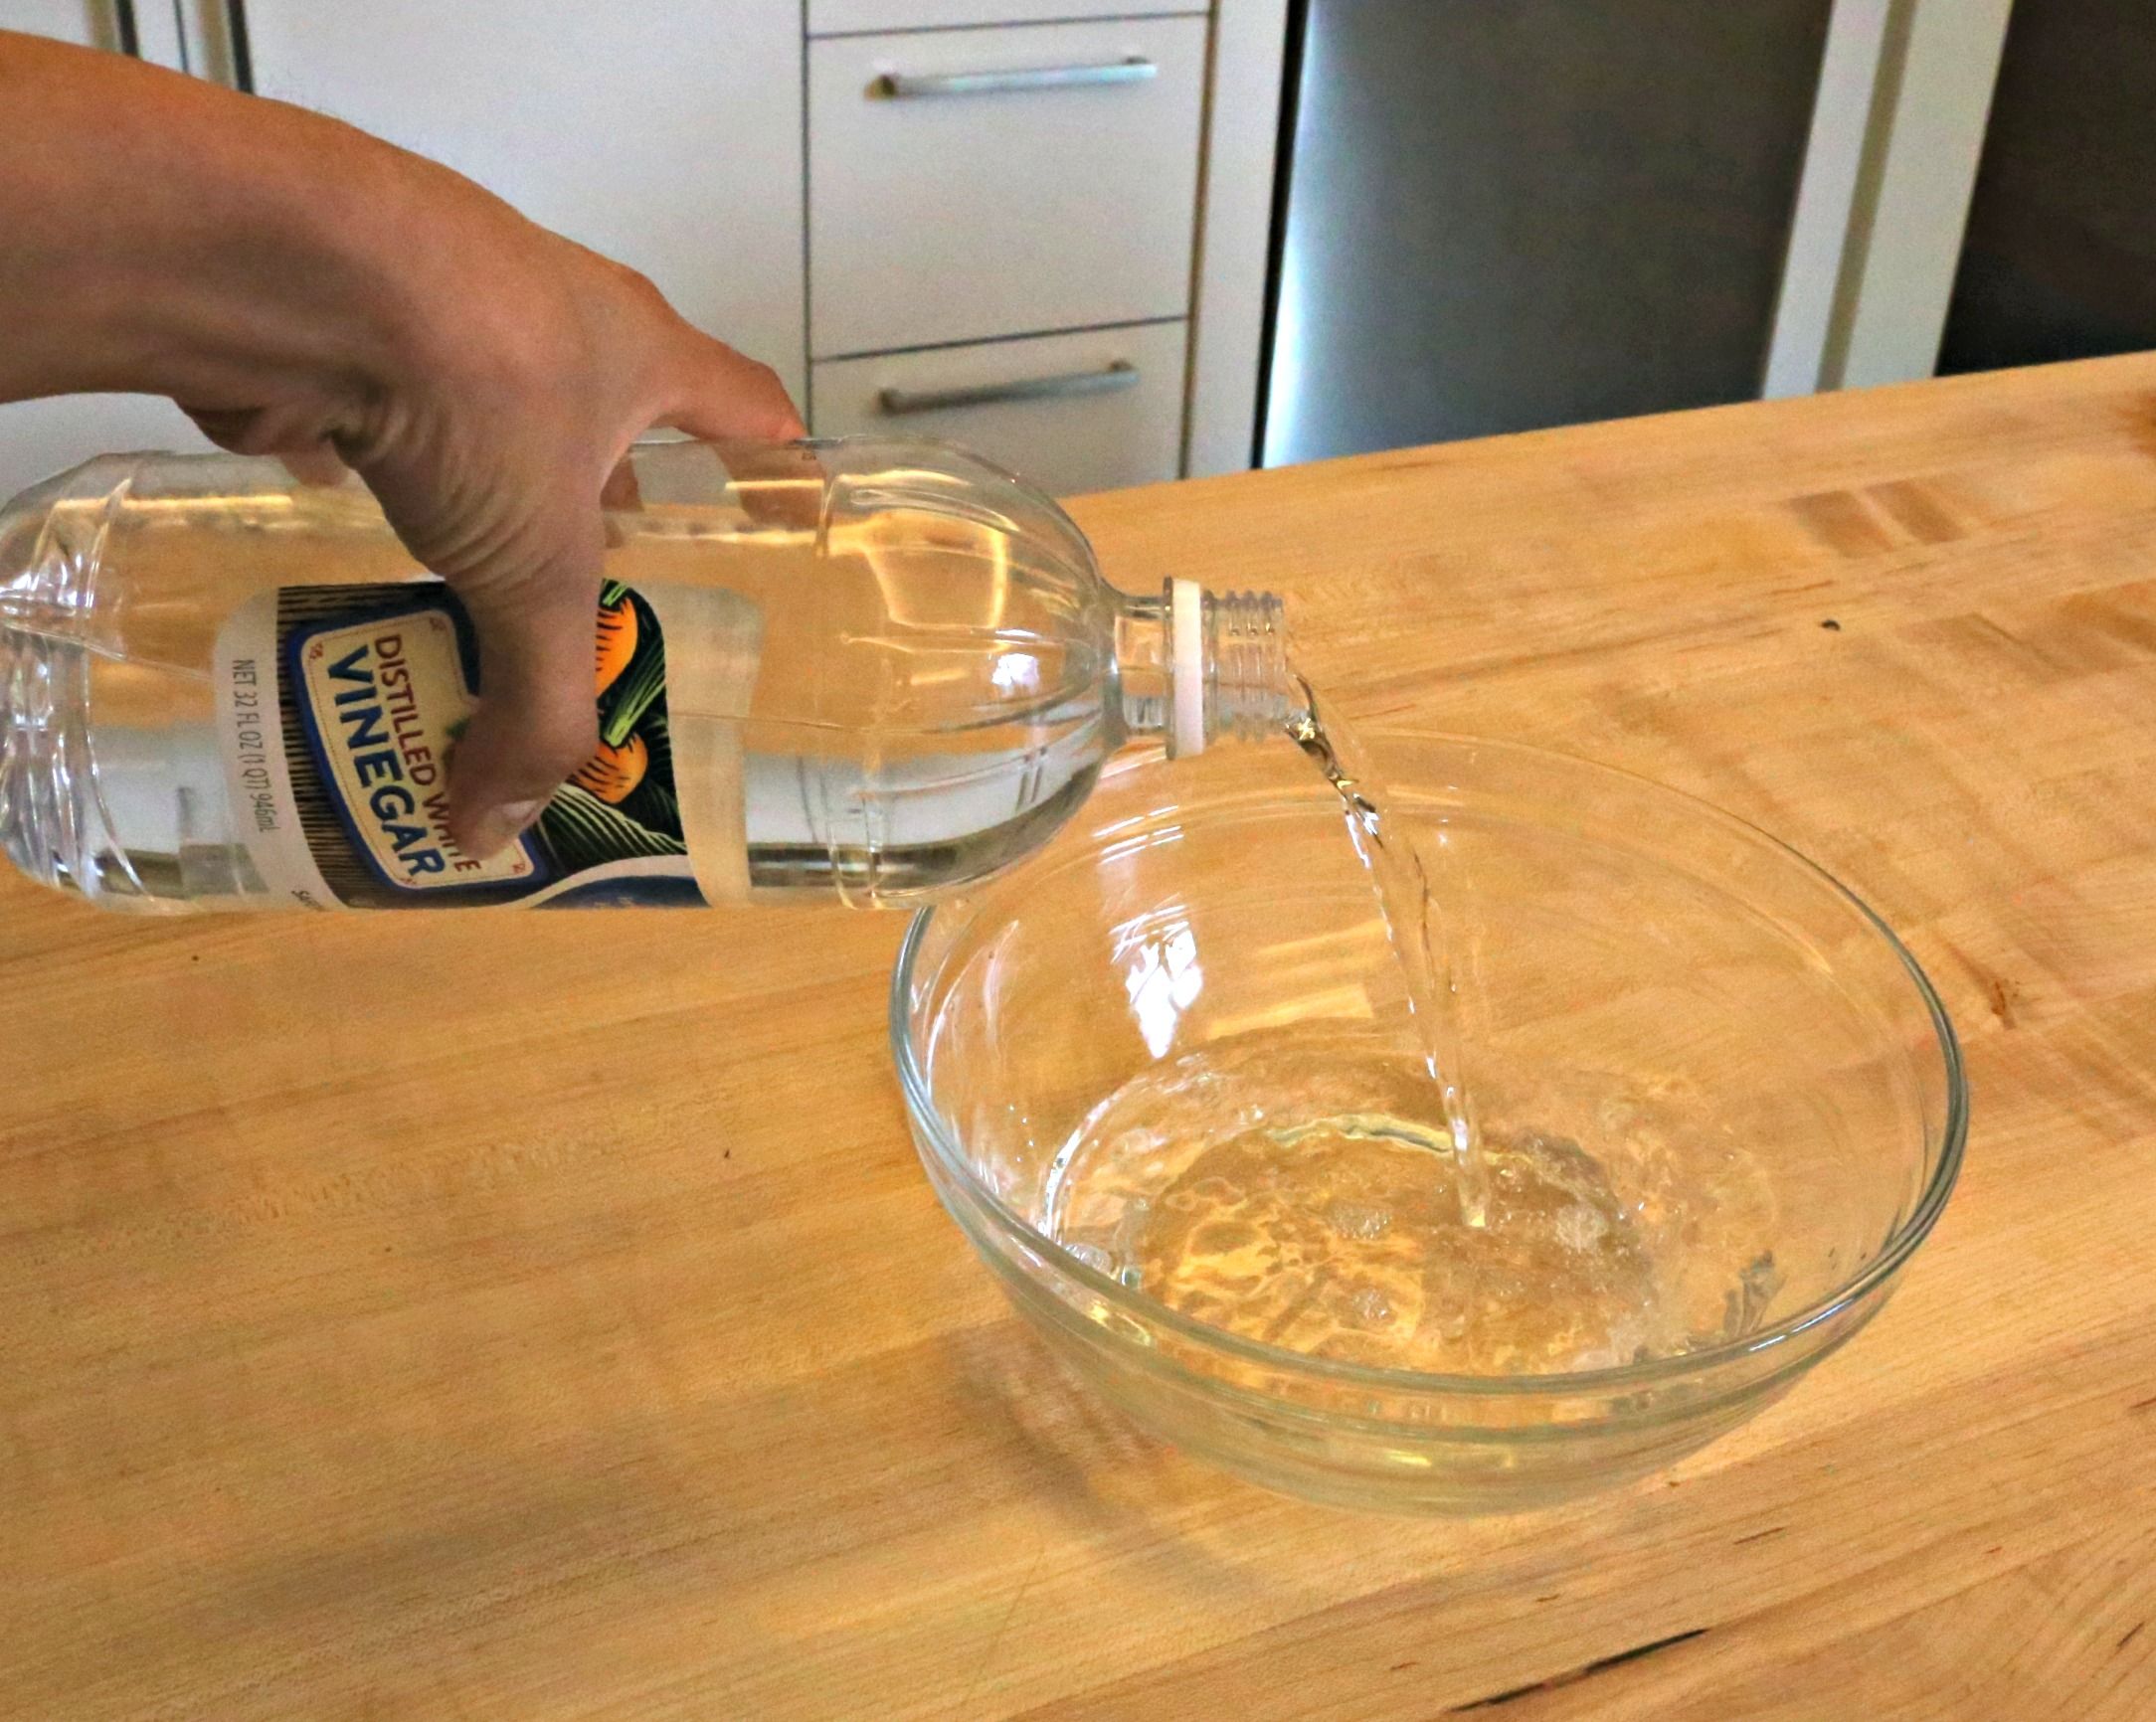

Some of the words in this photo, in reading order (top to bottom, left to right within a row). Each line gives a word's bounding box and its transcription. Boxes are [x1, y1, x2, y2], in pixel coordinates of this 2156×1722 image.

[232, 659, 257, 686] NET
[233, 691, 259, 708] 32
[374, 633, 438, 786] DISTILLED
[236, 712, 261, 728] FL
[238, 731, 264, 750] OZ
[237, 753, 267, 765] (1
[327, 644, 446, 877] VINEGAR
[241, 768, 272, 789] QT)
